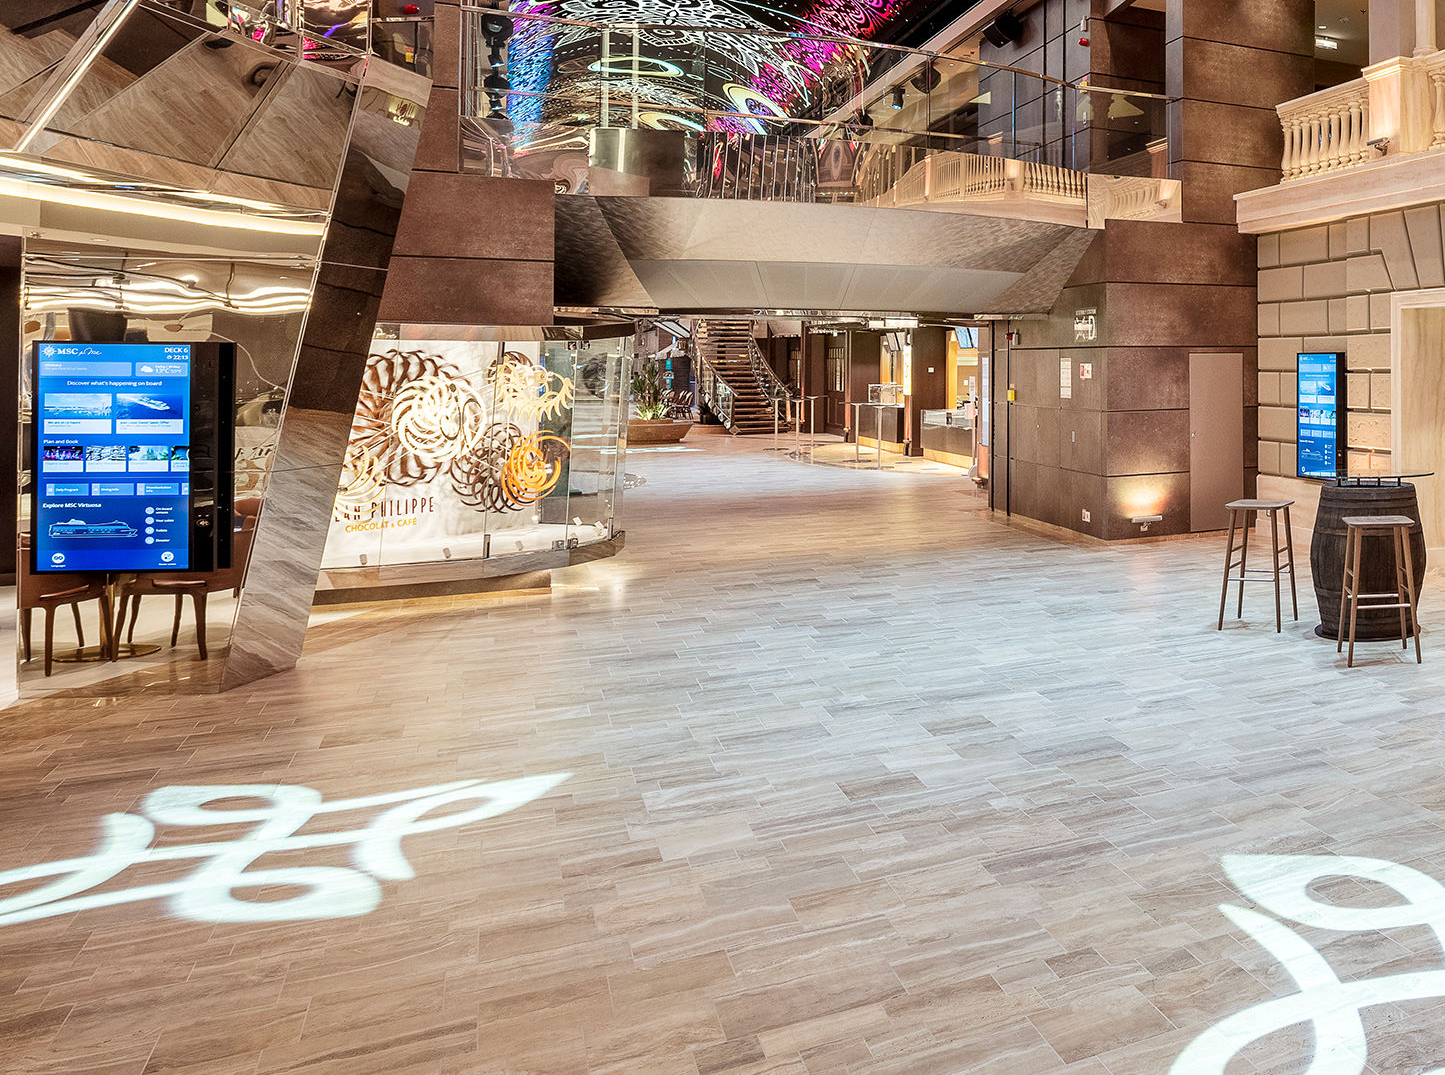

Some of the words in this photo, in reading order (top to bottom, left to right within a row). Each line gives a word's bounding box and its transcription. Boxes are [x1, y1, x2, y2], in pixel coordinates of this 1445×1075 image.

[372, 496, 434, 518] PHILIPPE
[345, 521, 388, 533] CHOCOLAT
[397, 517, 417, 527] CAFÉ
